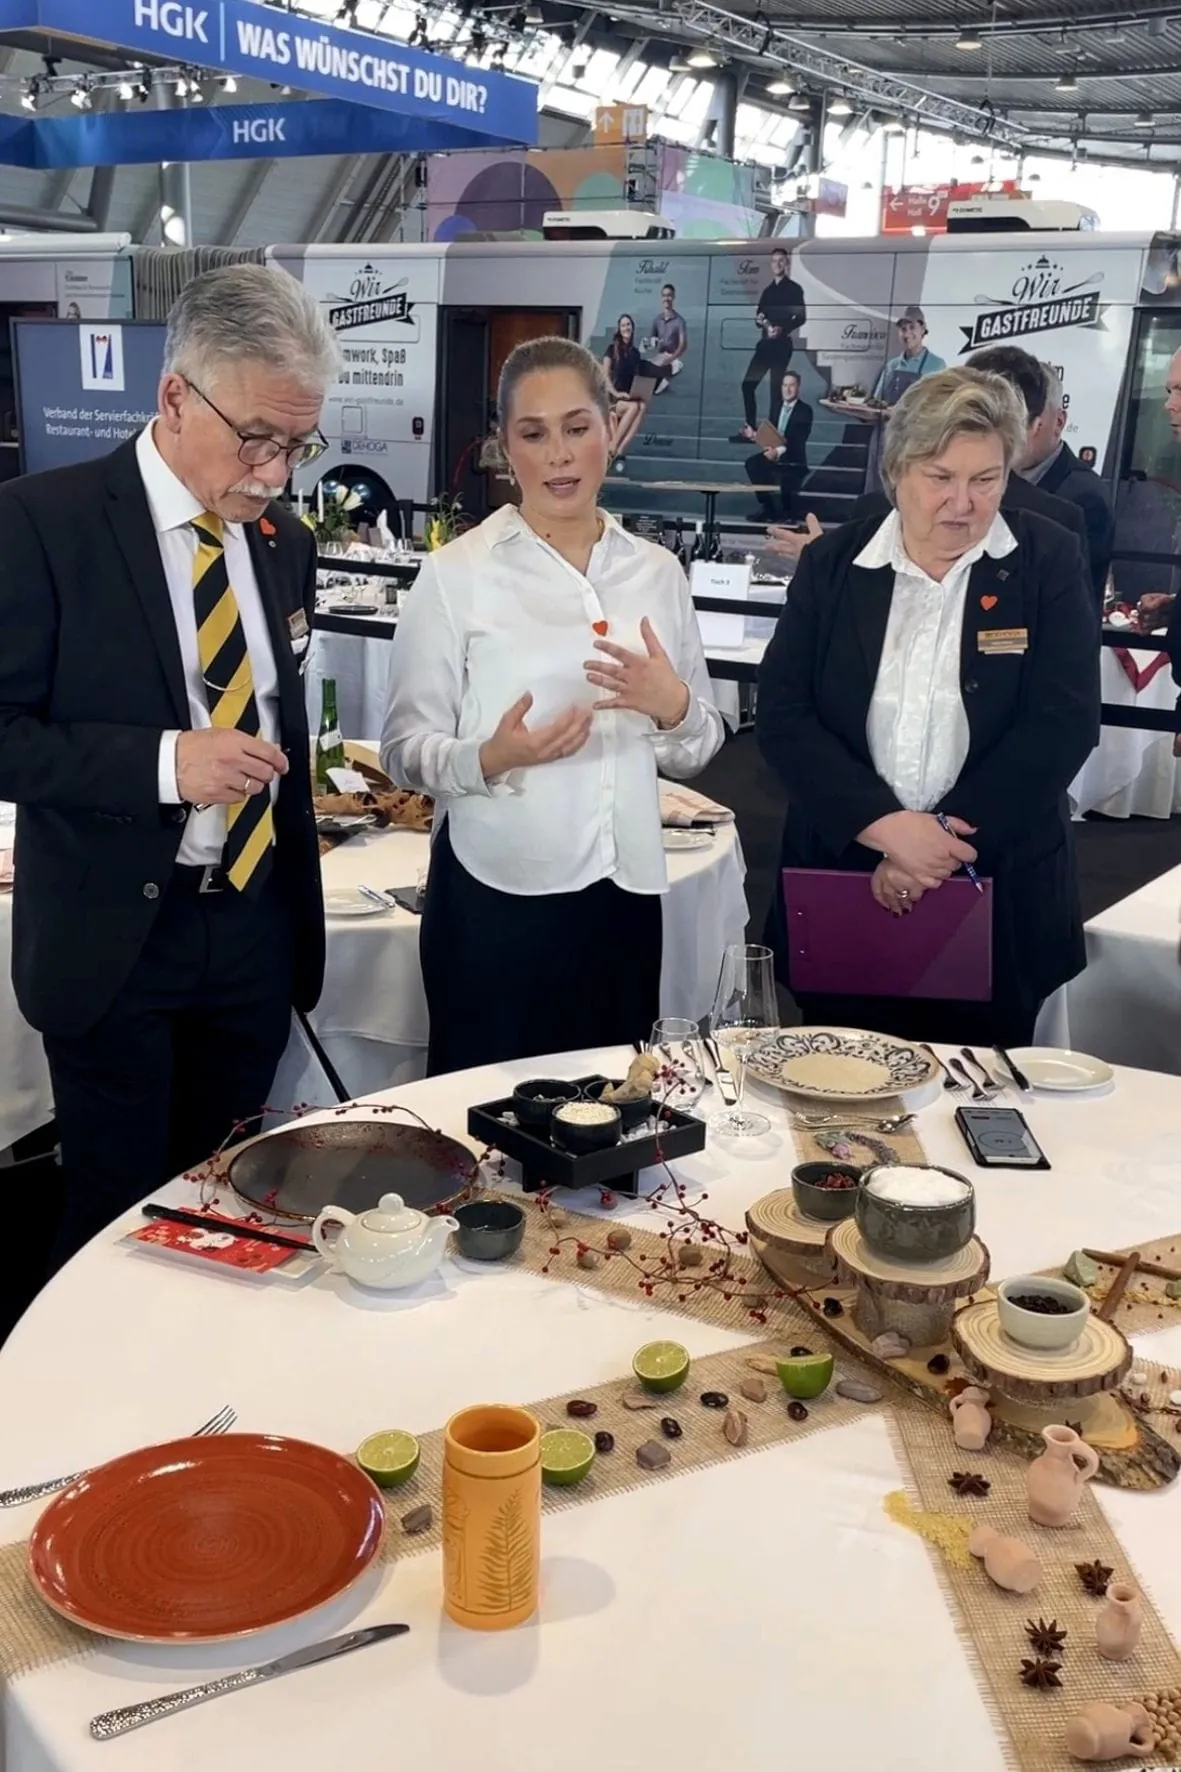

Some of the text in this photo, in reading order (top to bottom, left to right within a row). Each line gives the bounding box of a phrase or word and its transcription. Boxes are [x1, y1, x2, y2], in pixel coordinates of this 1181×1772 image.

[134, 0, 208, 43] HGK
[236, 21, 488, 114] WAS WÜNSCHST DU DIR?
[232, 117, 286, 143] HGK
[928, 196, 940, 216] 9
[350, 276, 381, 302] Wir
[1012, 272, 1060, 303] Wir
[332, 297, 403, 327] GASTFREUNDE
[980, 296, 1093, 338] GASTFREUNDE
[353, 368, 404, 386] mittendrin
[43, 407, 77, 420] Verband
[79, 410, 93, 420] der
[46, 423, 92, 437] Restaurant-
[94, 427, 111, 438] und
